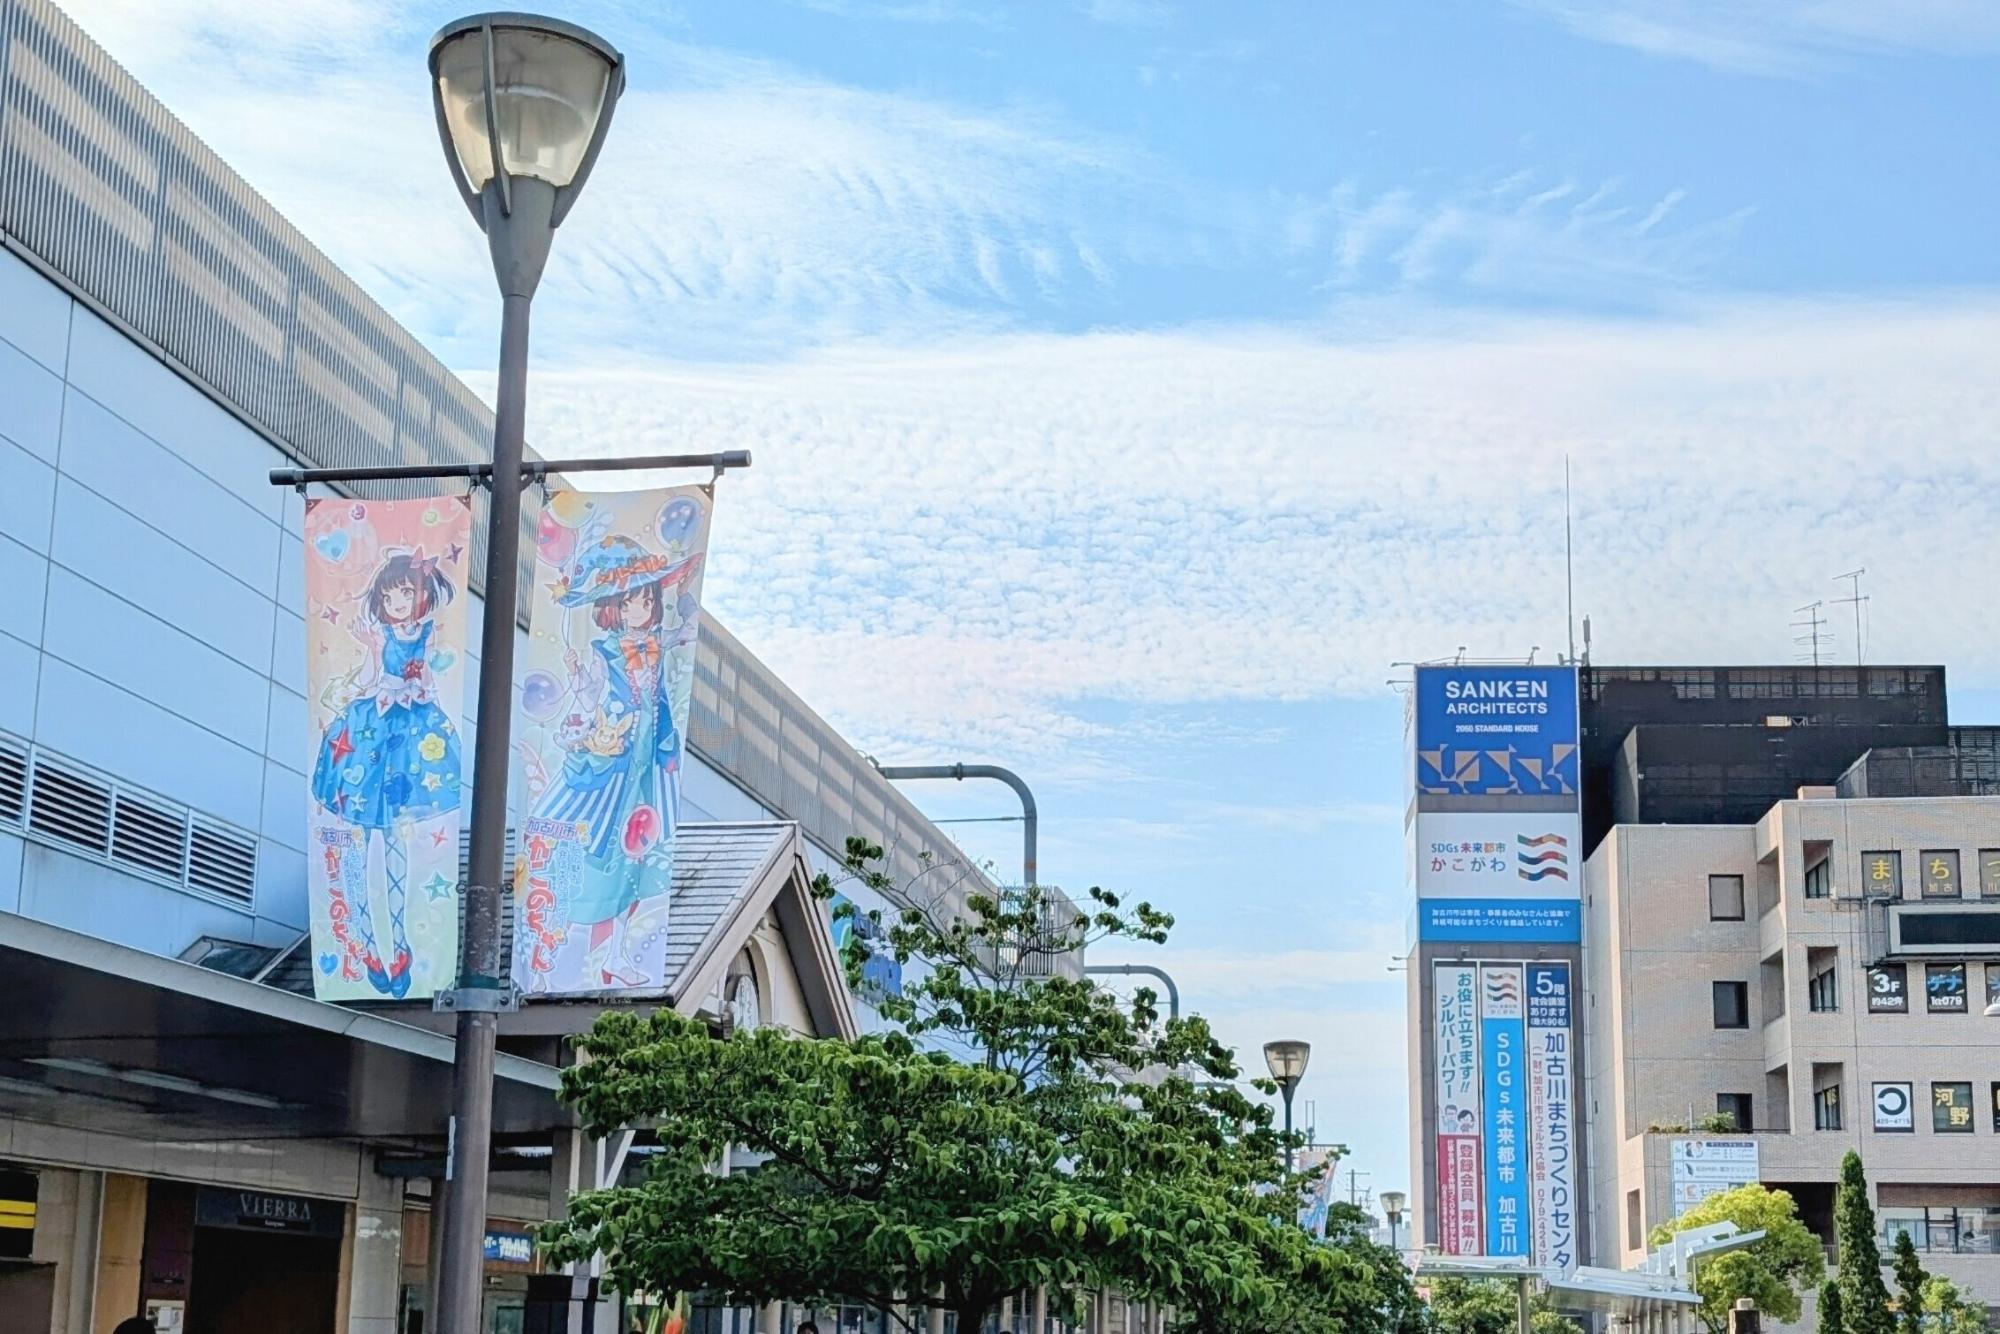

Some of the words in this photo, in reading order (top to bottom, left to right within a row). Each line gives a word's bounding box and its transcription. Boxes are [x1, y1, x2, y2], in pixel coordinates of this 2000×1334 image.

[1446, 680, 1548, 698] SANKEN
[1446, 702, 1548, 715] ARCHITECTS
[1475, 725, 1513, 733] STANDARD
[1431, 857, 1506, 872] かこがわ
[1536, 972, 1565, 995] 5階
[1873, 974, 1900, 993] 3F
[1530, 1007, 1567, 1017] あります
[1441, 995, 1456, 1099] シルバーパワー
[1935, 1088, 1970, 1125] 河野
[240, 1193, 311, 1220] VIERRA
[1498, 1196, 1517, 1254] 加古川
